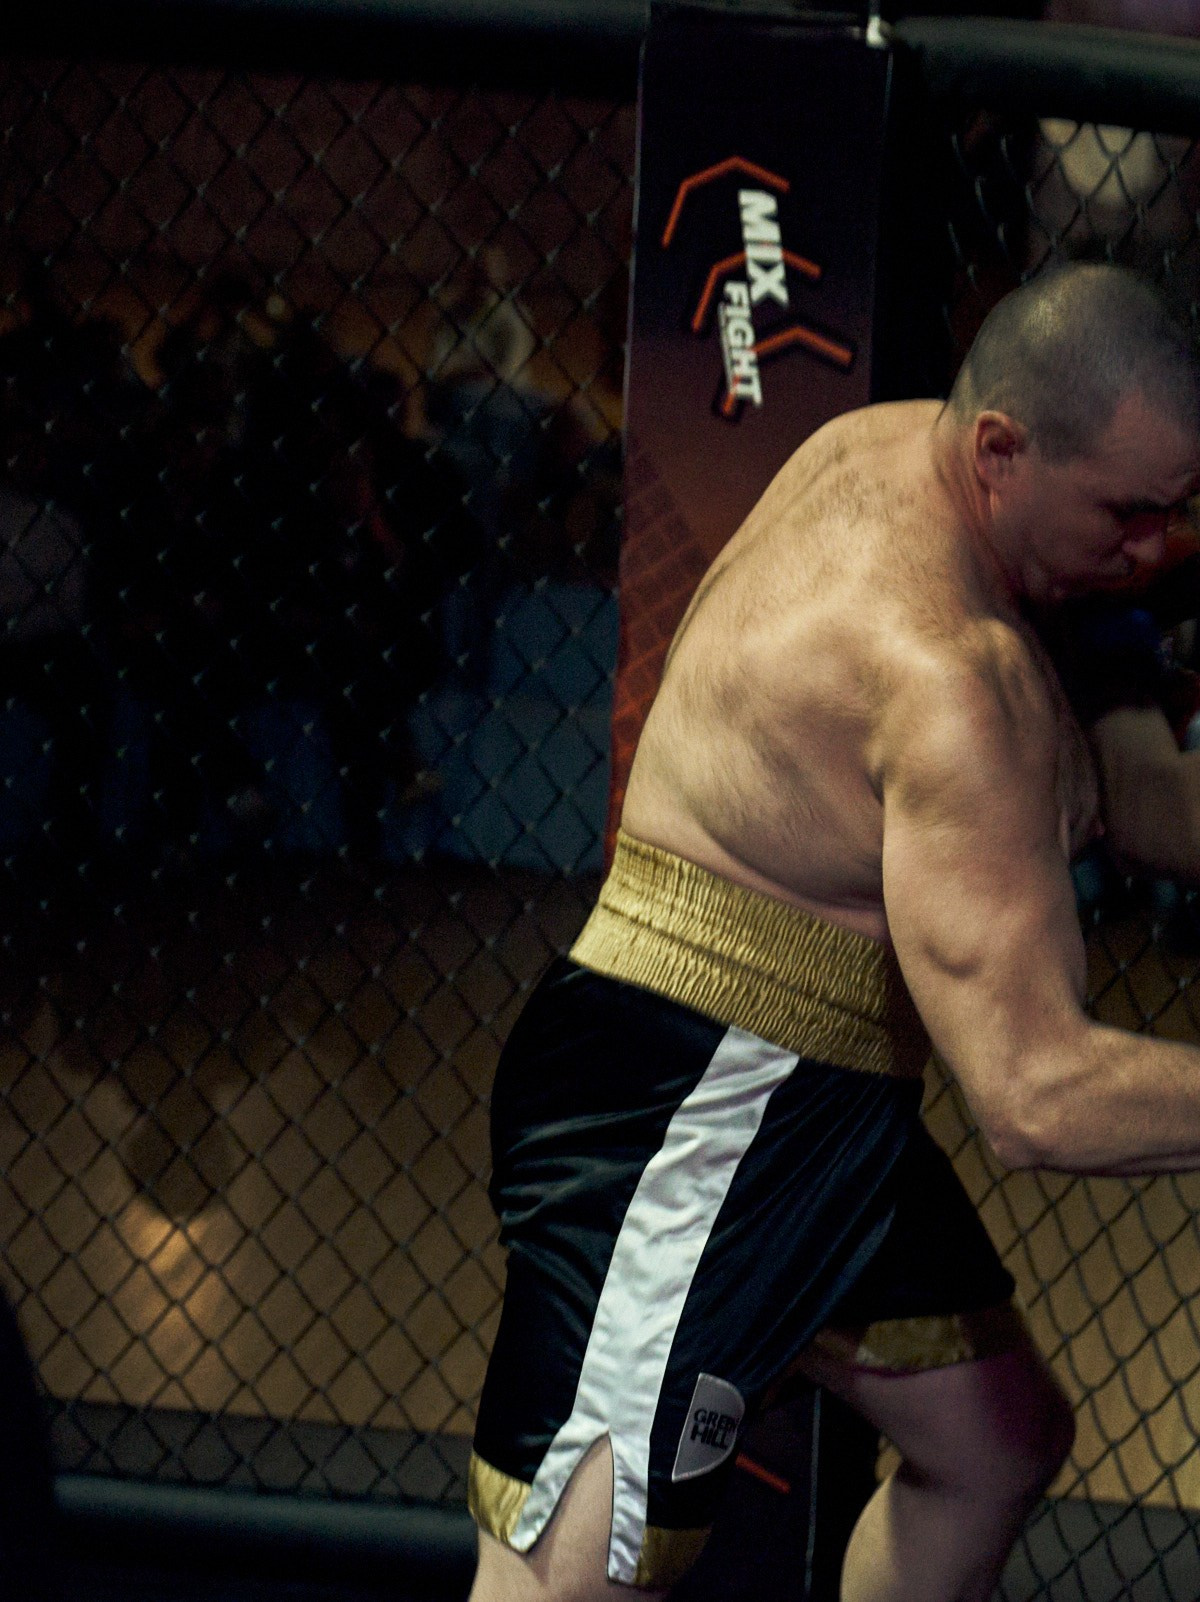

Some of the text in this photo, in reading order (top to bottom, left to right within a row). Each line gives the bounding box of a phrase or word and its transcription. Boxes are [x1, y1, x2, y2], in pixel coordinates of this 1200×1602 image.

[737, 188, 789, 308] MIX
[720, 280, 763, 406] FIGHT
[691, 1423, 728, 1450] HILL
